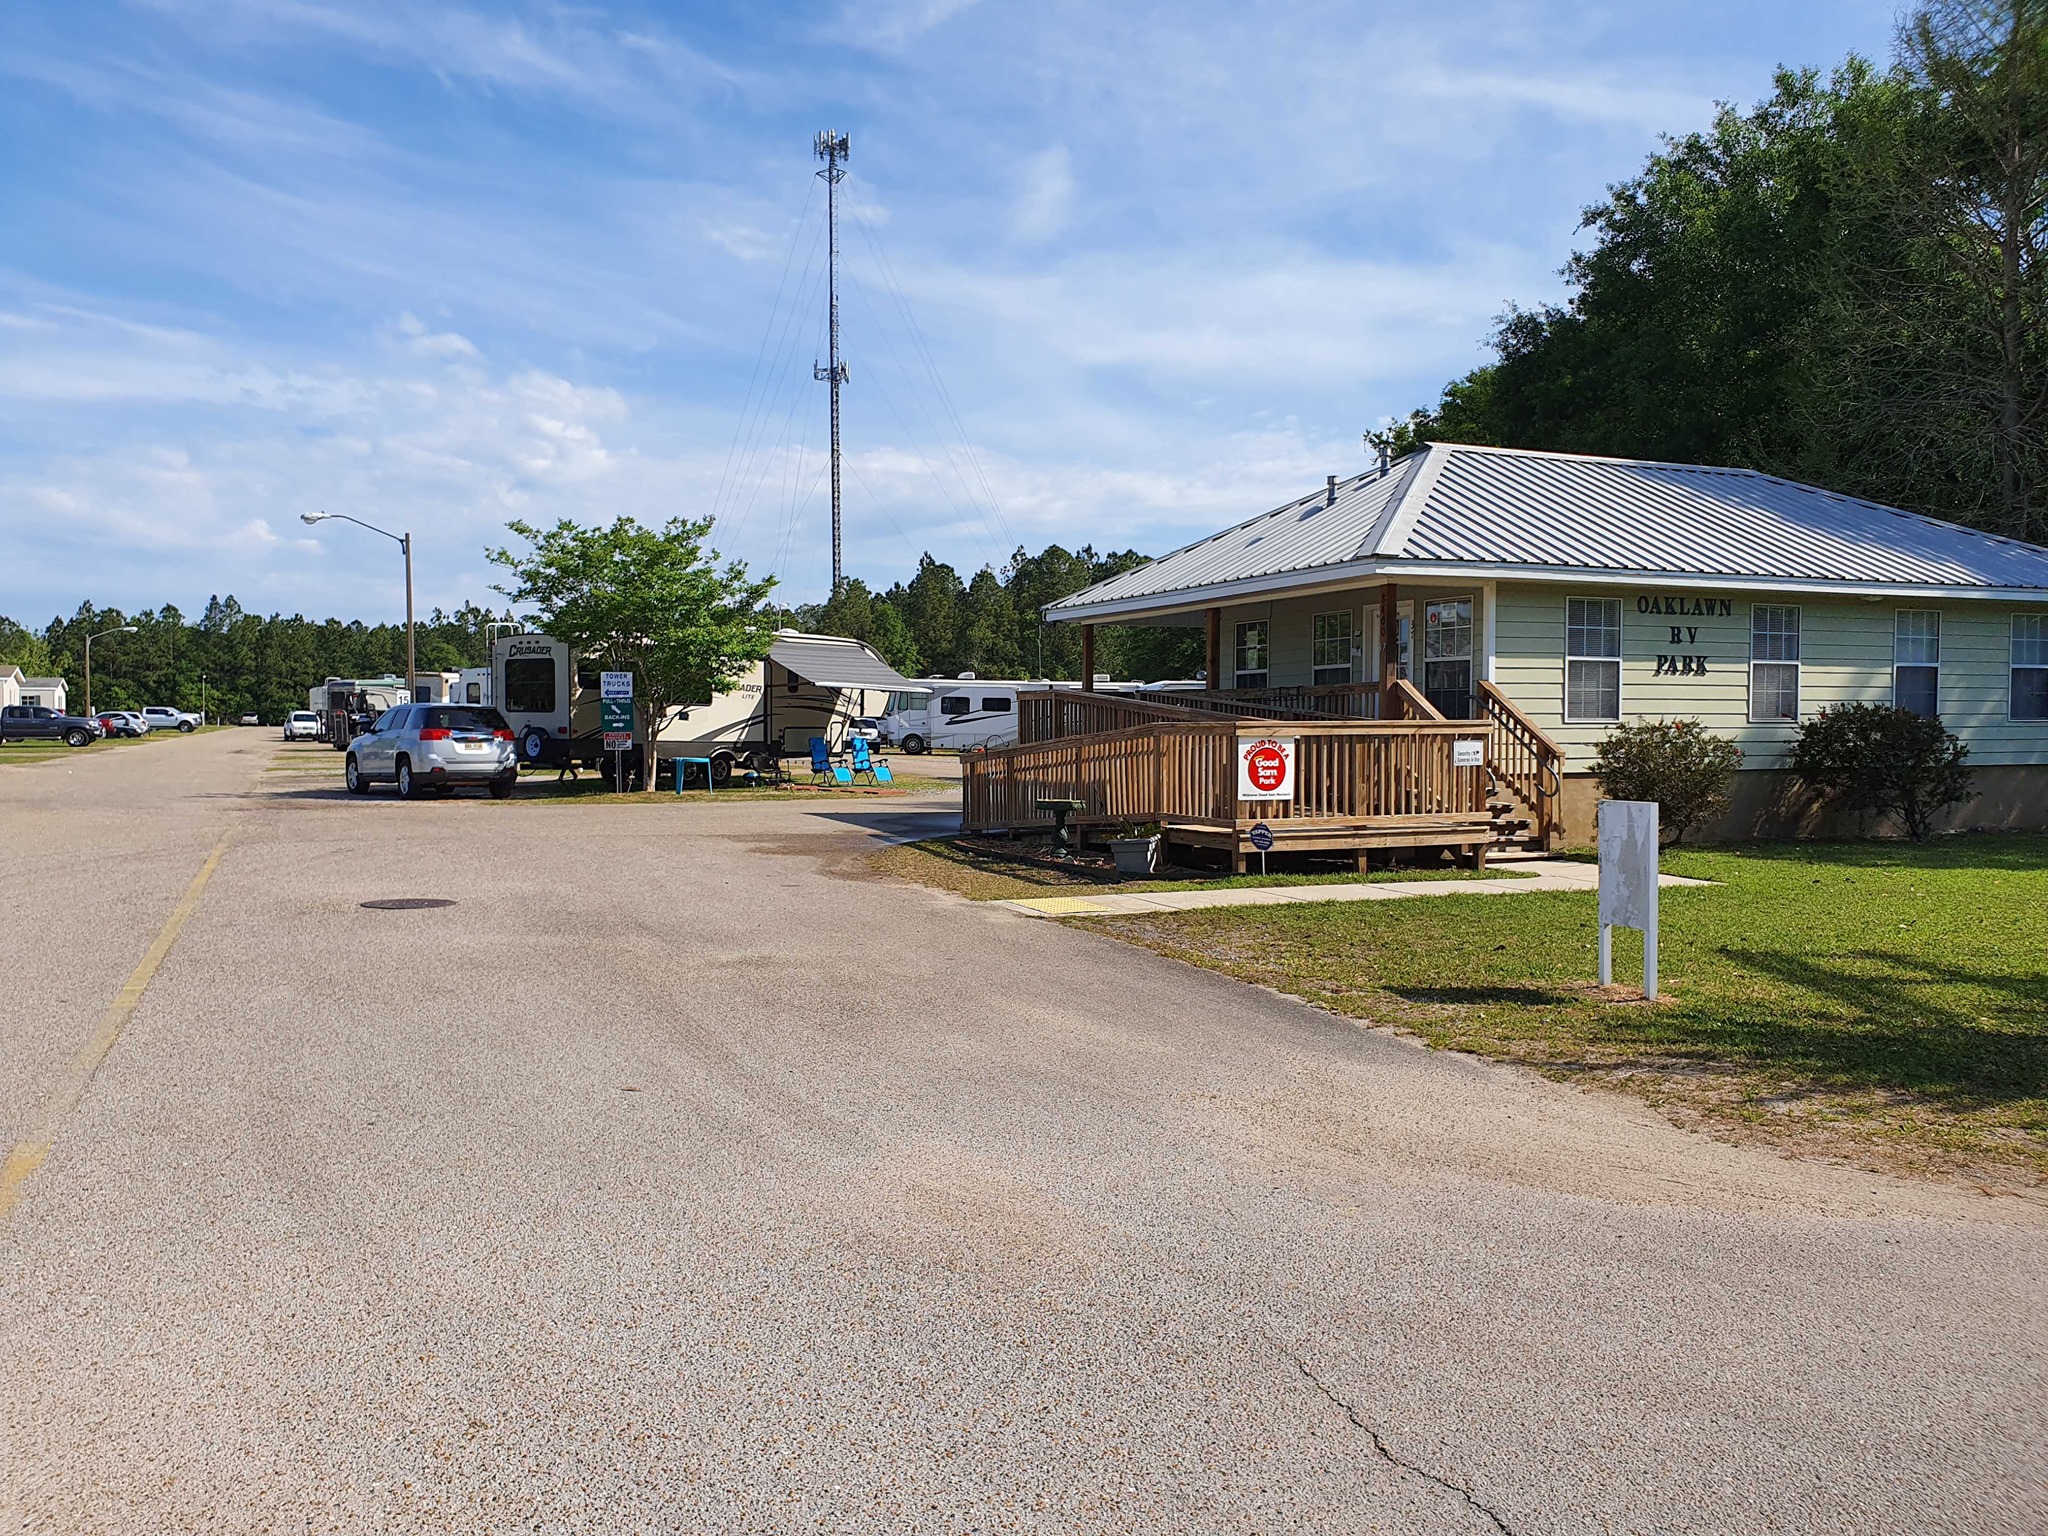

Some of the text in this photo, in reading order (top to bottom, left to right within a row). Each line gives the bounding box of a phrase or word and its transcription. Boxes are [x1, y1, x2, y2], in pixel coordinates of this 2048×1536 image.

[1637, 595, 1732, 616] OAKLAWN
[1669, 626, 1698, 645] RV
[509, 644, 552, 658] CRUSADER
[1656, 654, 1709, 673] PARK
[398, 695, 409, 705] 15
[605, 740, 617, 749] NO
[1243, 739, 1290, 761] PROUD TO BE A
[1255, 757, 1279, 767] Good
[1257, 767, 1277, 776] Sam
[1259, 776, 1276, 785] Park
